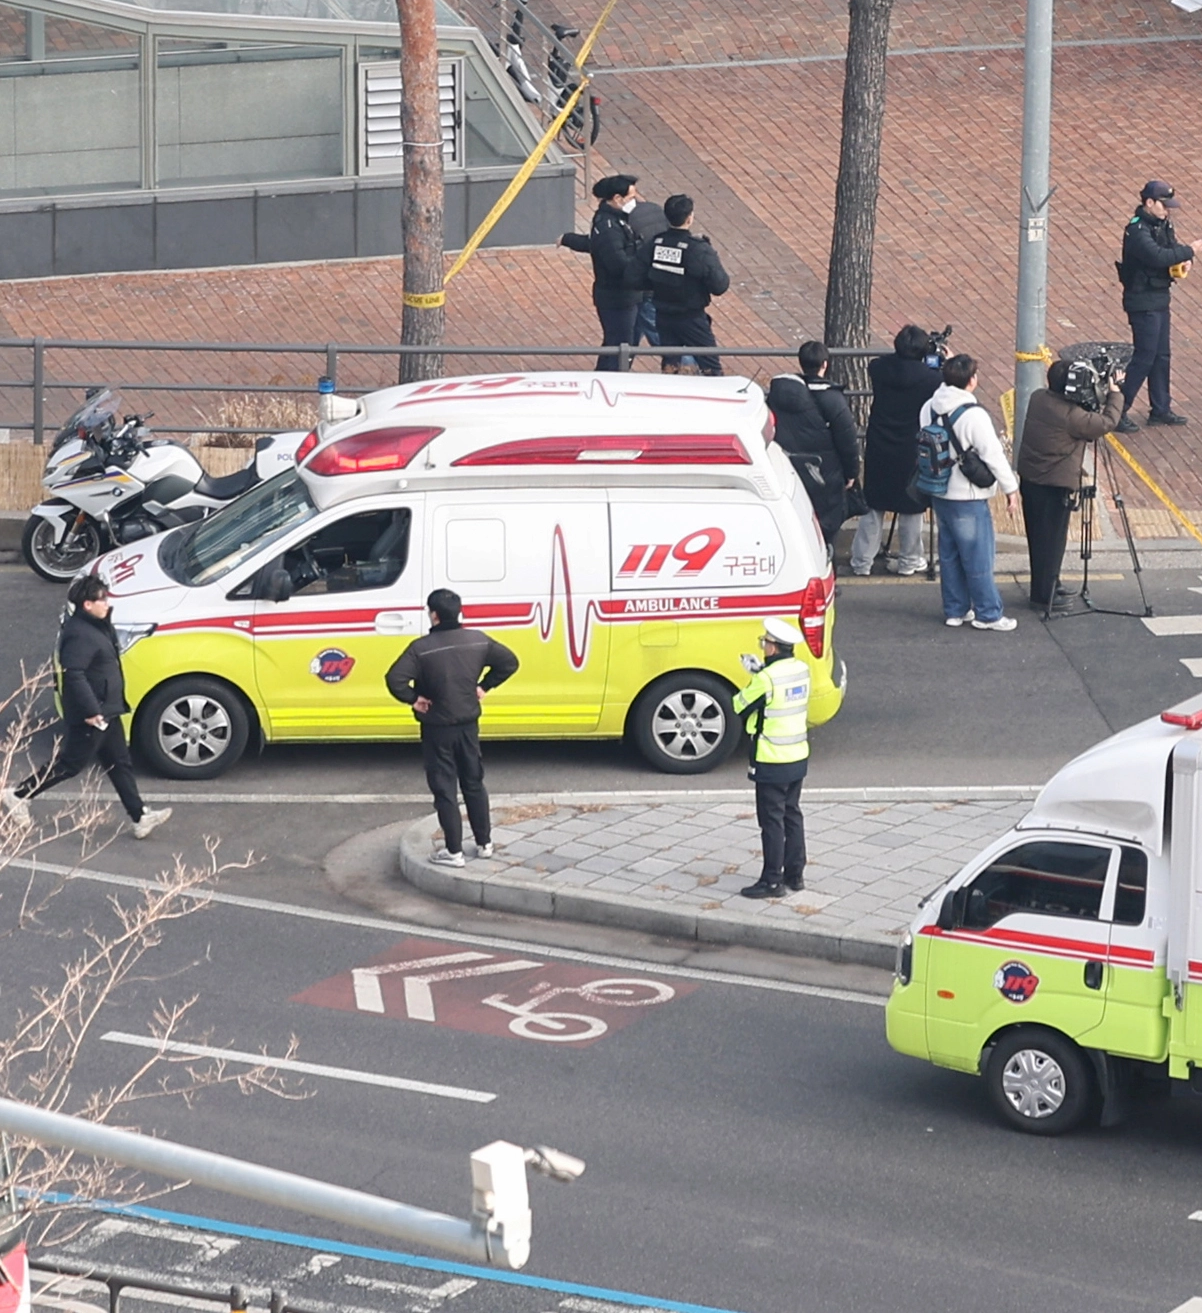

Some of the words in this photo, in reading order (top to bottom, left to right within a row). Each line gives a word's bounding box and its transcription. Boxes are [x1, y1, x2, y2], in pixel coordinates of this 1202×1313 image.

[615, 527, 726, 578] 119
[723, 555, 775, 576] 구급대
[624, 597, 720, 613] AMBULANCE
